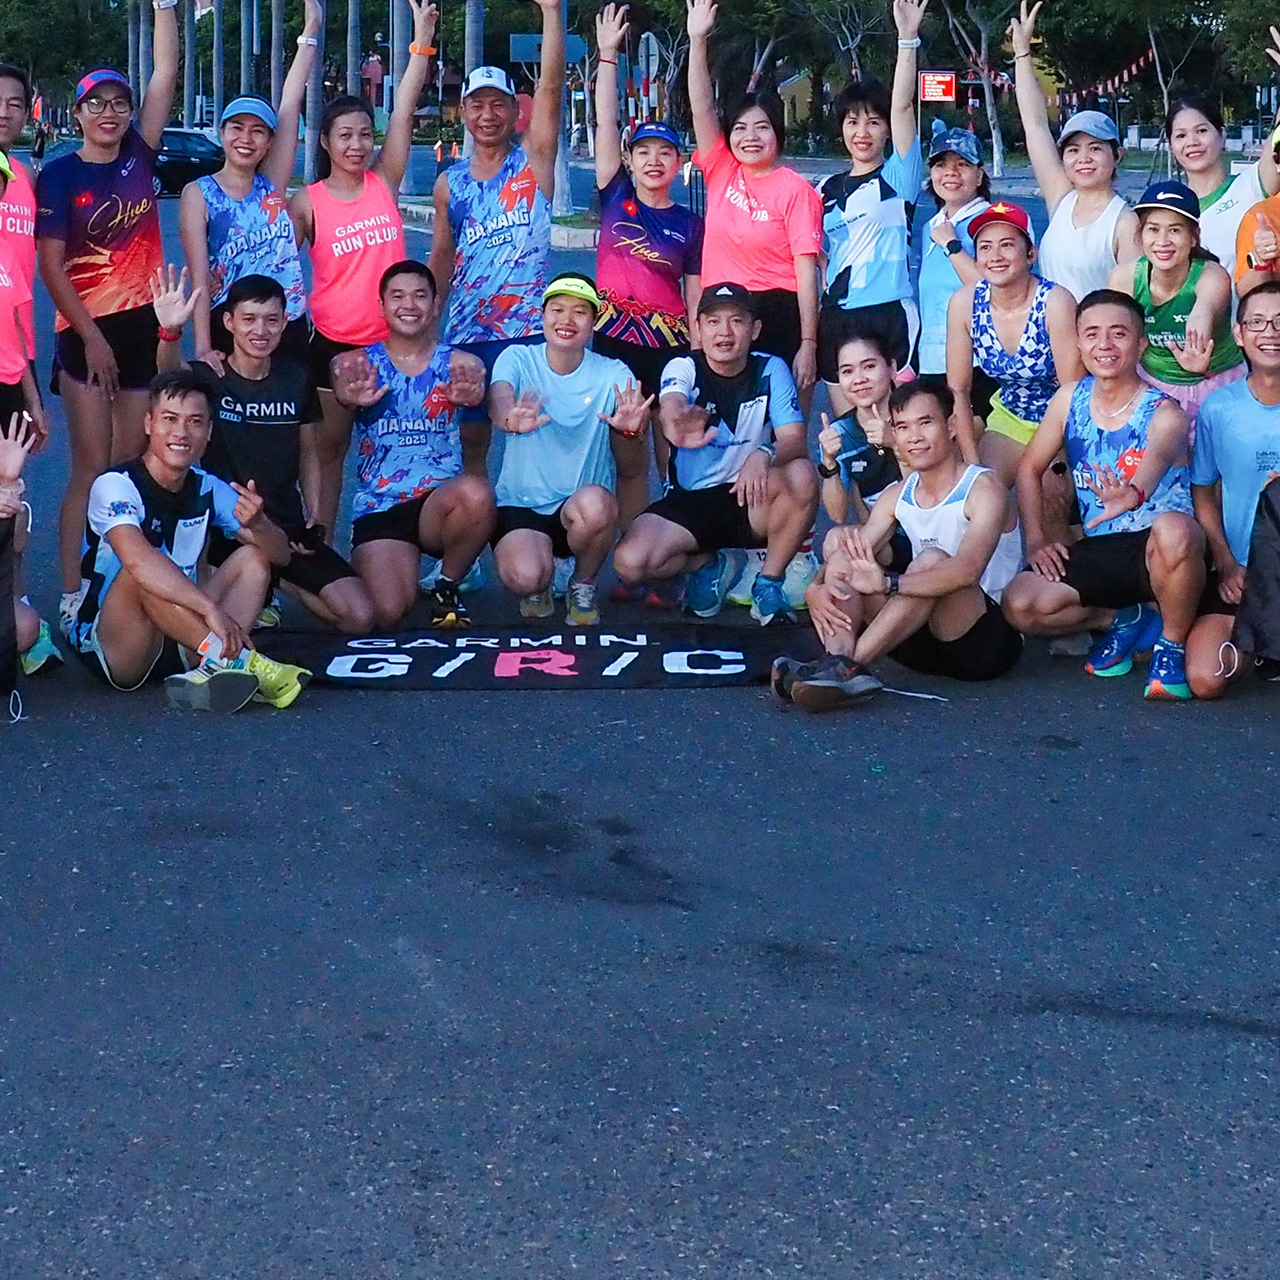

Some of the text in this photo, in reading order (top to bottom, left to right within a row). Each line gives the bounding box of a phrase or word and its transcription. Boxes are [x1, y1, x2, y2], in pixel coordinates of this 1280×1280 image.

[334, 214, 391, 238] GARMIN
[331, 226, 398, 258] RUN CLUB
[220, 396, 297, 417] GARMIN
[346, 634, 649, 648] GARMIN
